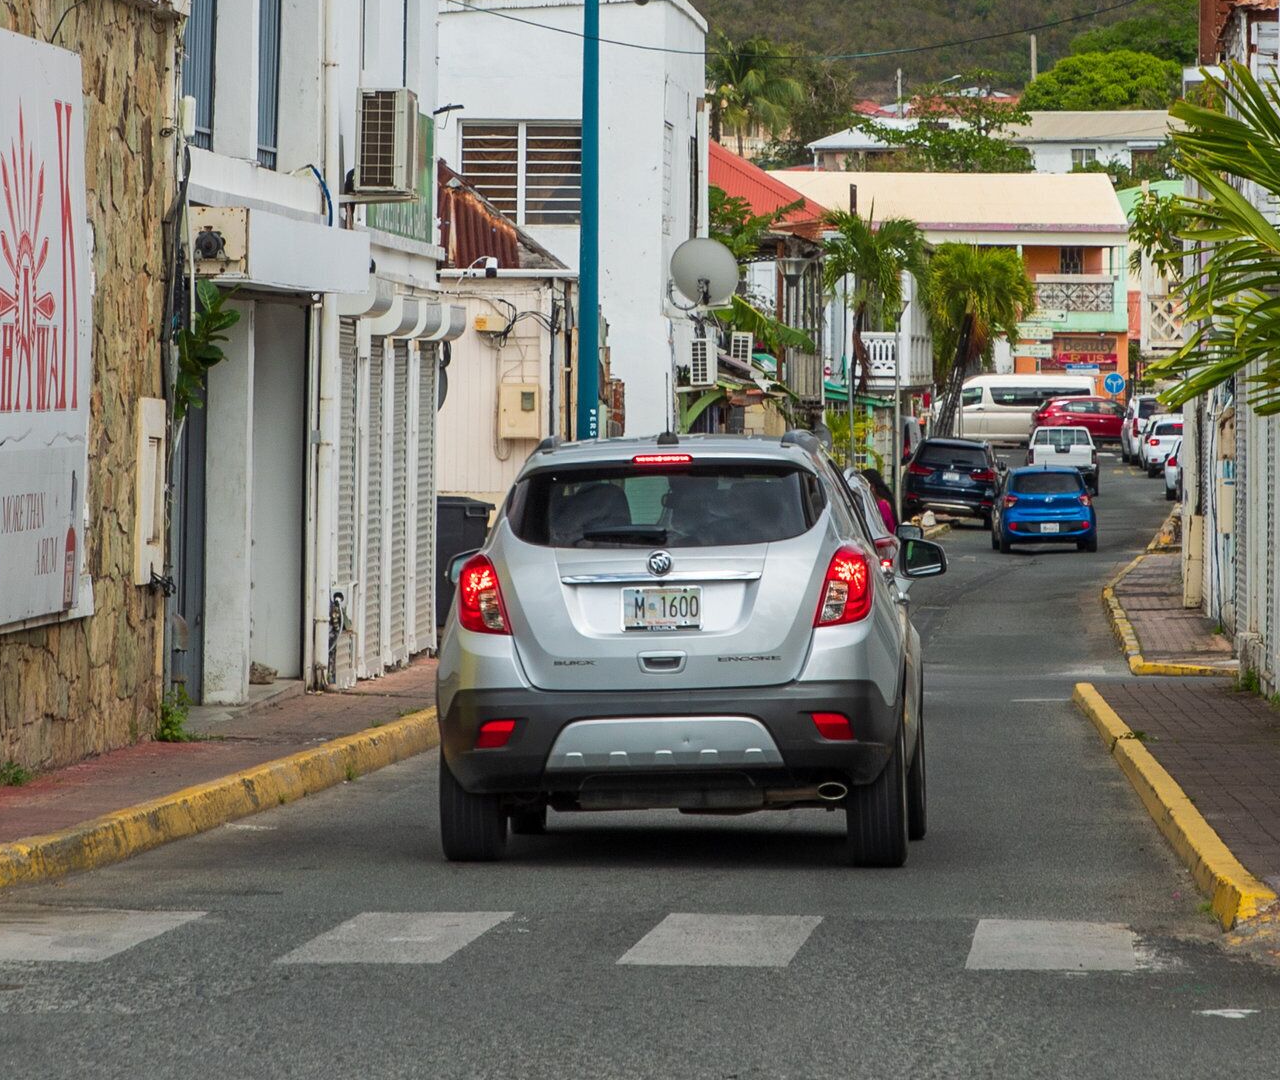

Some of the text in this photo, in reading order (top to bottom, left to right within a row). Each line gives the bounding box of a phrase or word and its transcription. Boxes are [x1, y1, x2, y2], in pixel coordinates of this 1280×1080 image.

[1063, 340, 1114, 353] Beauty
[1070, 354, 1105, 362] R US
[634, 595, 699, 619] M 1600
